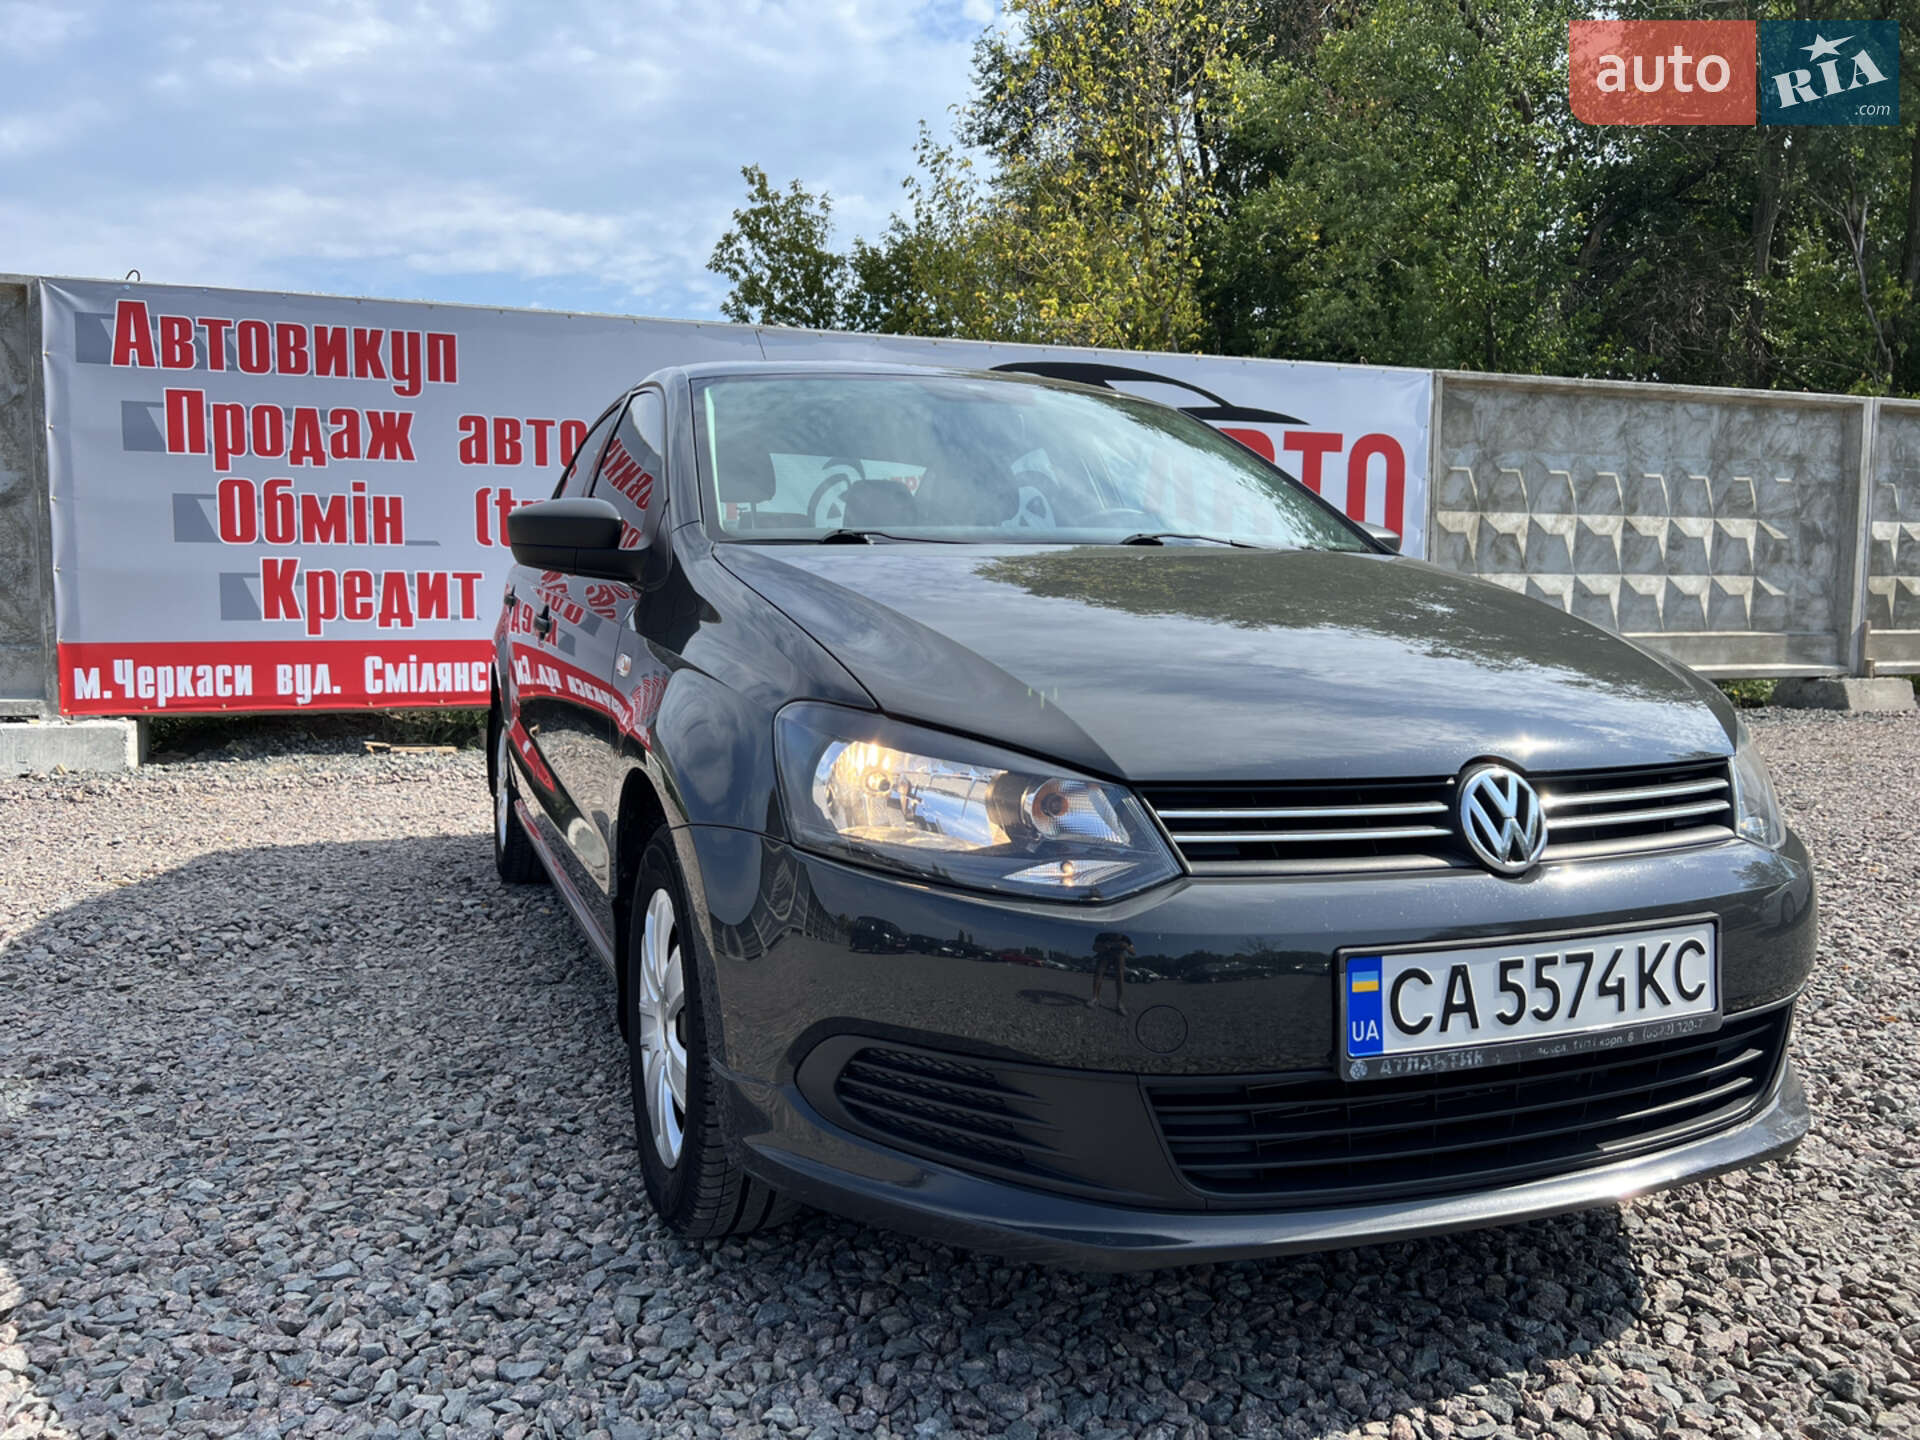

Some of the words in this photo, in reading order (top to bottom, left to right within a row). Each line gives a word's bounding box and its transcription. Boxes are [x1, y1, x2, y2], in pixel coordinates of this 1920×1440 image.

[111, 300, 458, 397] Автовикуп
[163, 388, 416, 472] Продаж
[217, 478, 405, 545] Обмін
[260, 557, 483, 637] Кредит
[276, 663, 341, 705] вул.
[364, 654, 491, 694] Смілянс
[1352, 1019, 1379, 1042] UA
